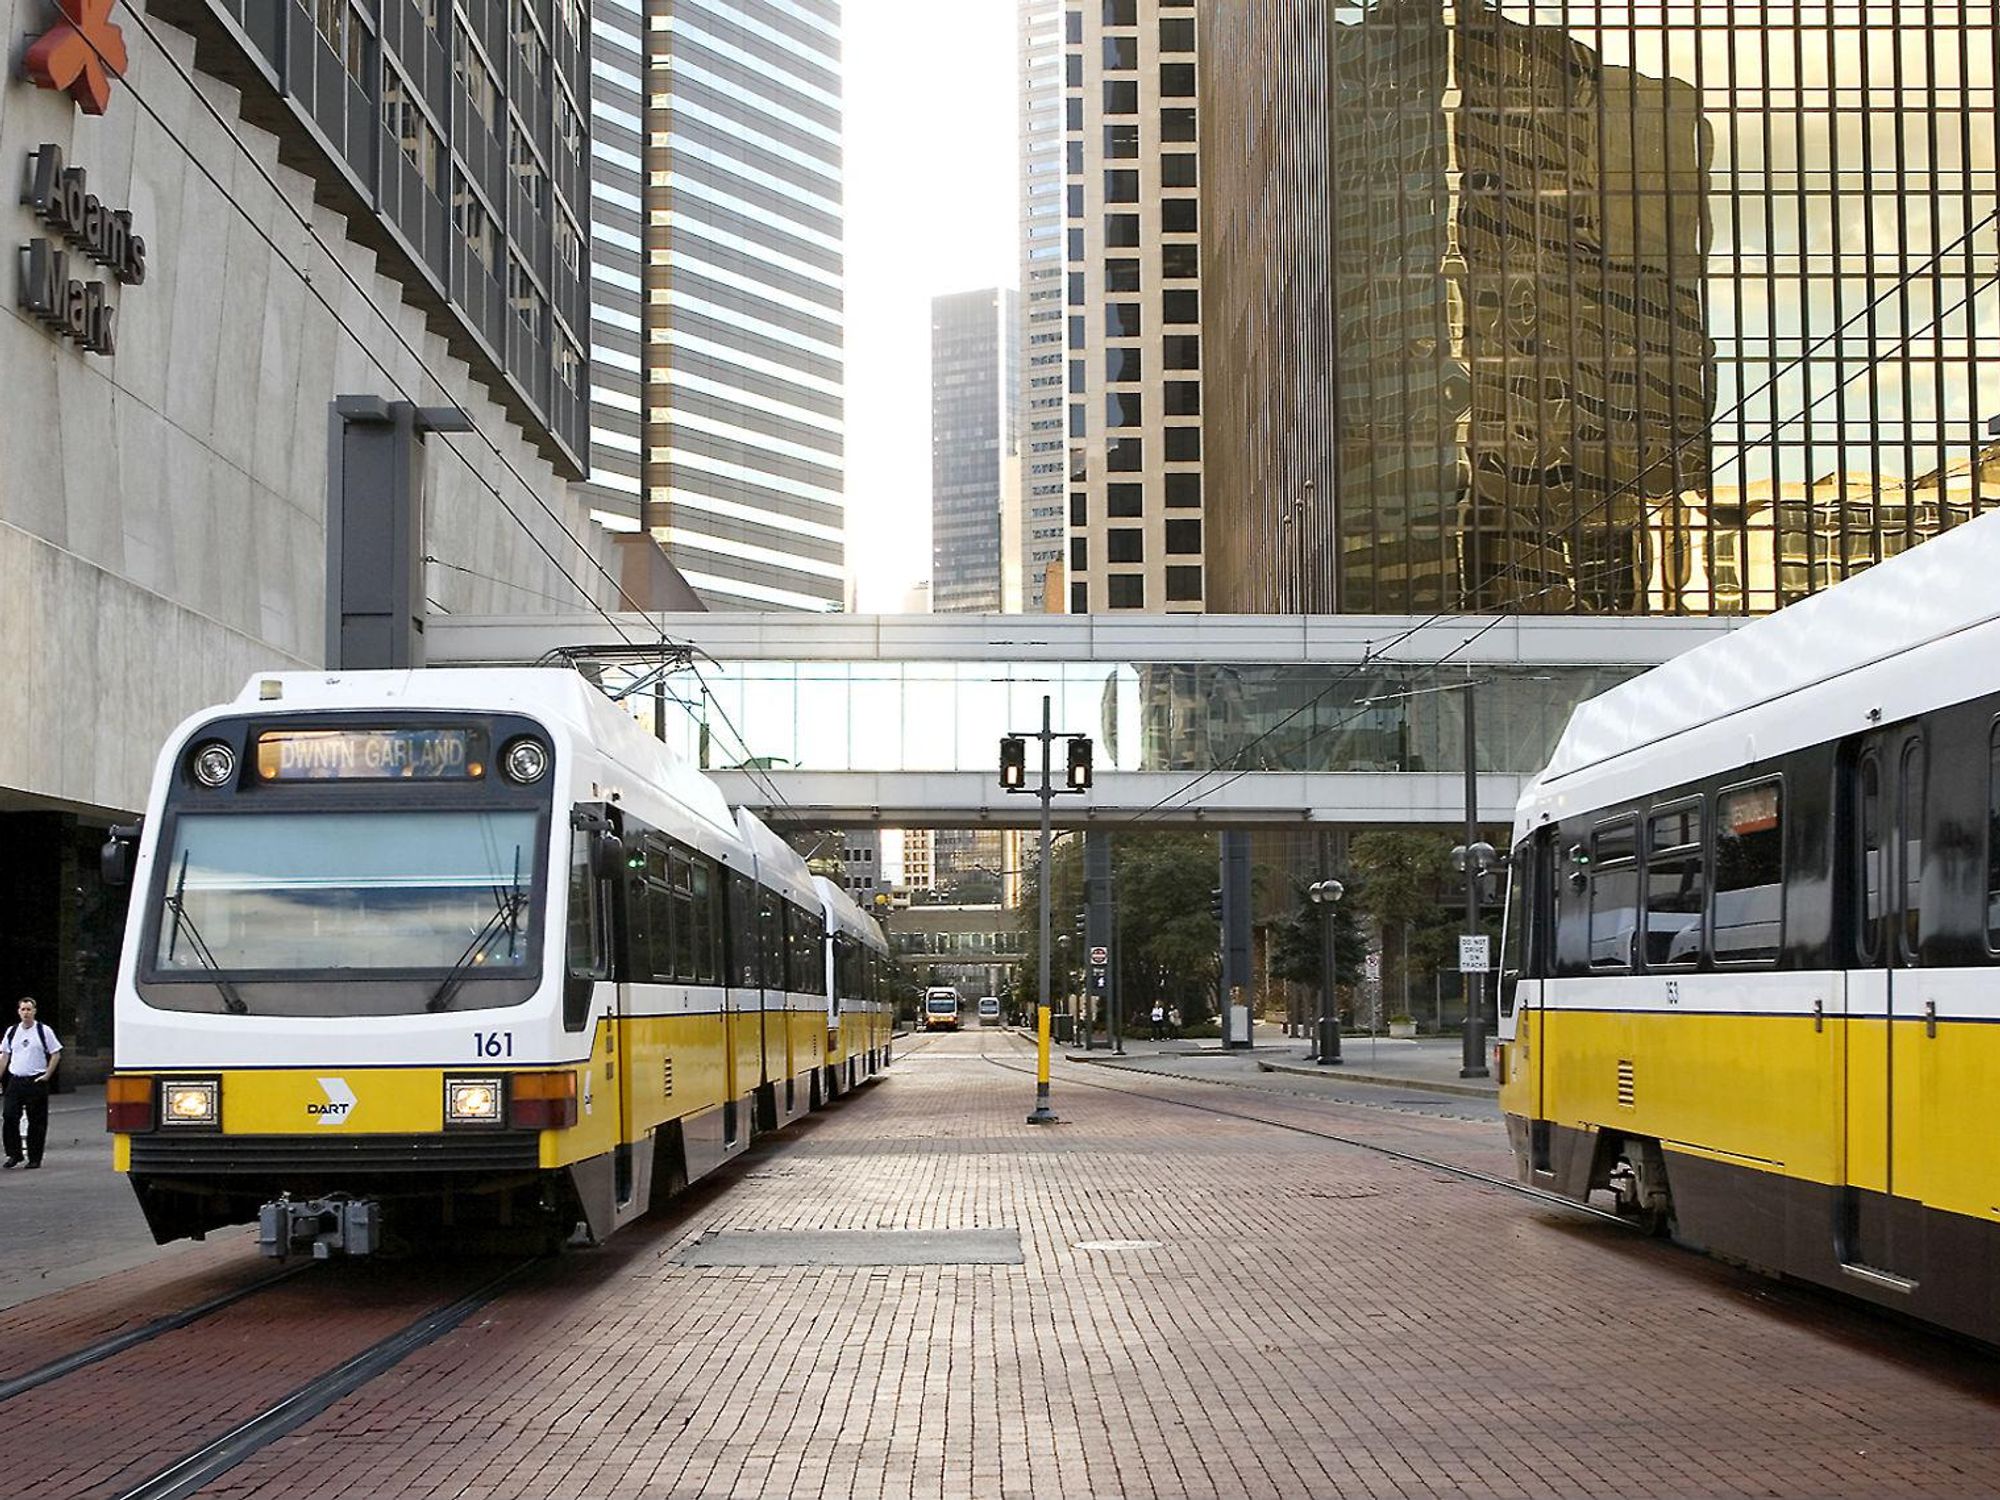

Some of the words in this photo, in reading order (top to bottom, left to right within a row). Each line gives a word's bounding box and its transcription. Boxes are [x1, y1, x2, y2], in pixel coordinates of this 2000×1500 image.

[28, 237, 115, 356] Mark
[281, 739, 355, 769] DWNTN
[364, 738, 465, 768] GARLAND
[474, 1032, 512, 1057] 161
[307, 1103, 349, 1114] DART
